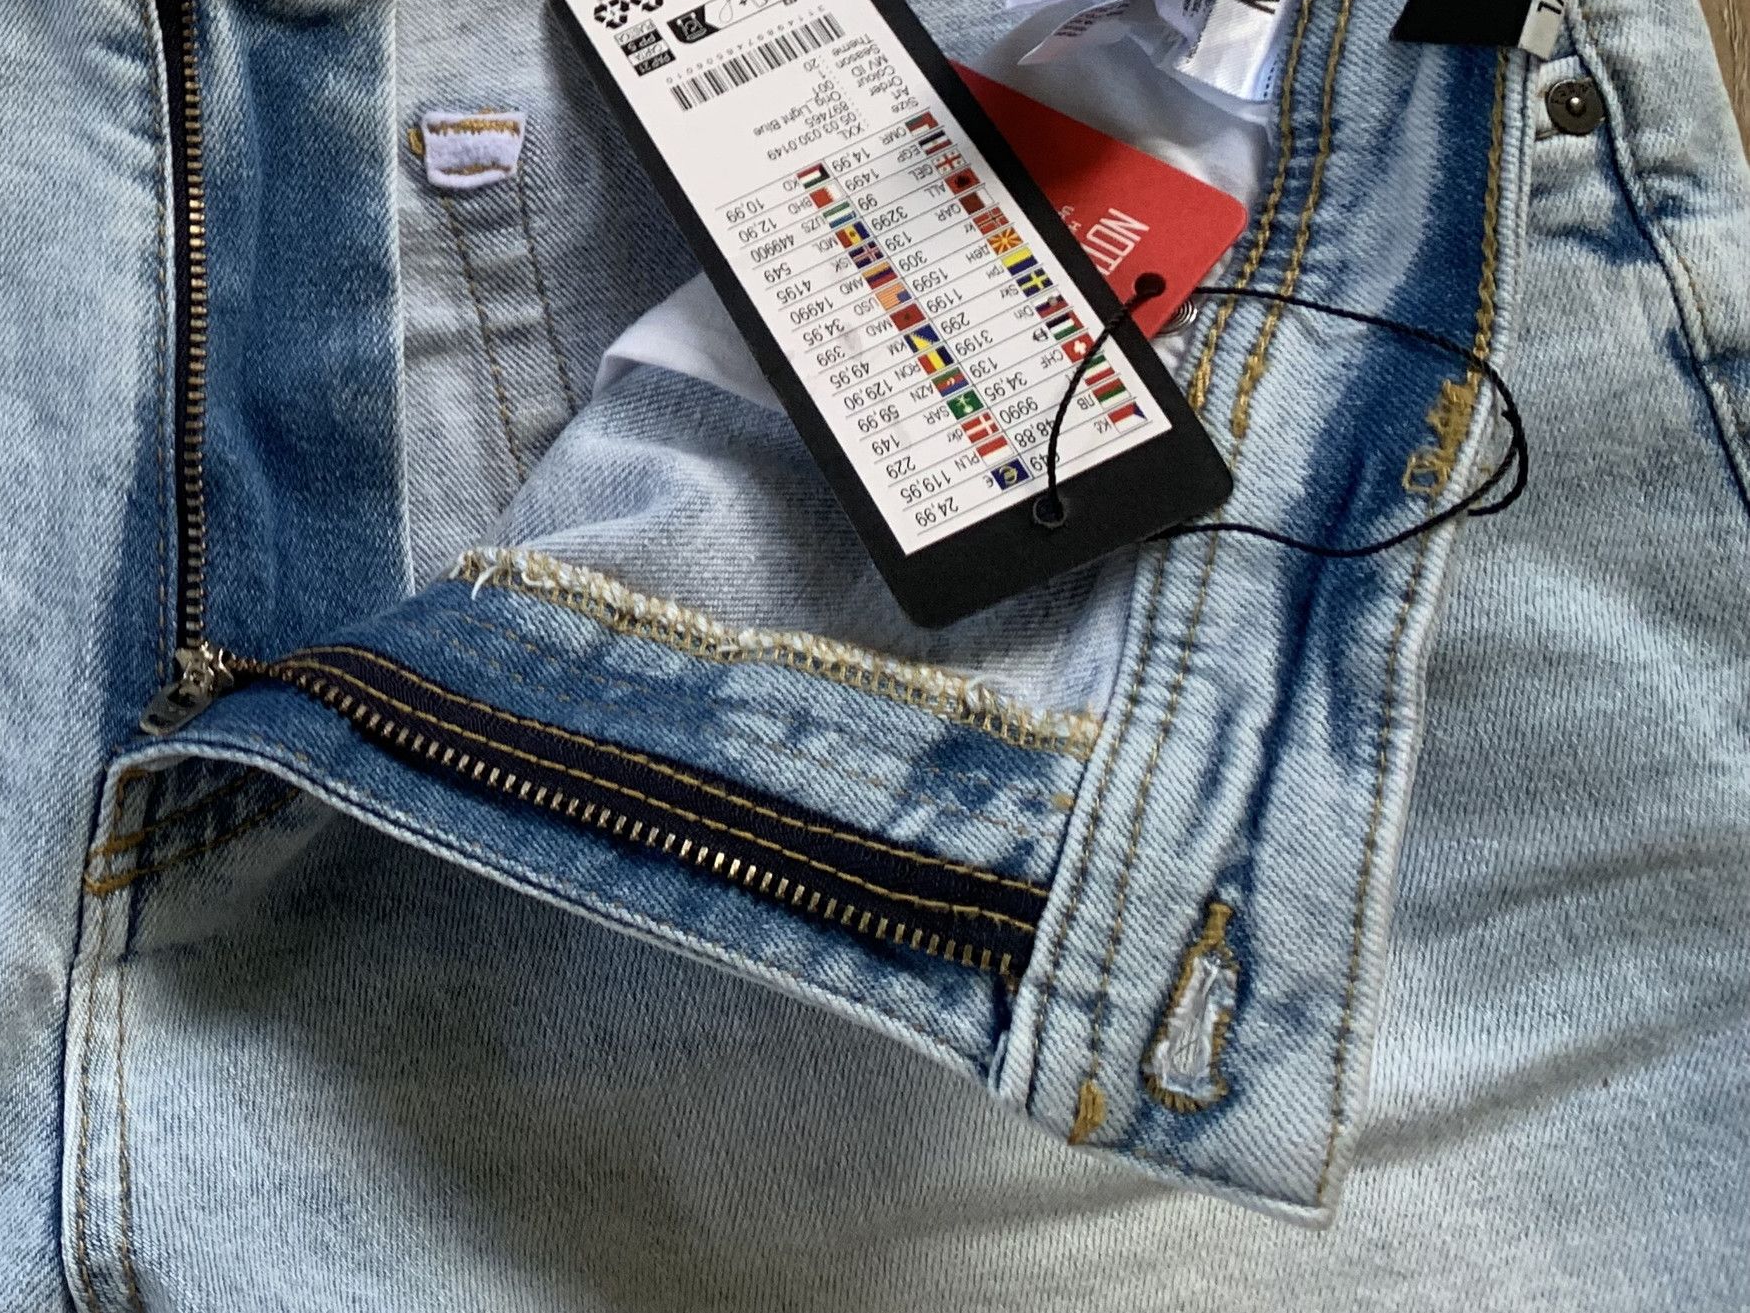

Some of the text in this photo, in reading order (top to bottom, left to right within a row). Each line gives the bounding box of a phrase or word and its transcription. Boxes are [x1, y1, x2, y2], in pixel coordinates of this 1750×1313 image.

[829, 32, 874, 58] Theme
[833, 42, 881, 71] Season
[853, 63, 897, 89] Colour
[865, 74, 904, 98] Order
[750, 117, 782, 139] Blue
[836, 95, 920, 141] Size XXL
[829, 145, 872, 174] 14,99
[842, 167, 881, 192] 1499
[854, 161, 936, 212] GEL 99
[723, 196, 766, 224] 10,99
[868, 180, 949, 232] ALL 3299
[735, 215, 778, 244] 12,90
[882, 229, 914, 252] 139
[748, 231, 798, 264] 449900
[761, 234, 839, 284] MDL 549
[895, 221, 976, 273] kr 309
[774, 254, 853, 305] ISK 4195
[909, 266, 950, 294] 1599
[787, 275, 866, 326] AMD 14990
[923, 287, 964, 315] 1199
[799, 295, 880, 347] USD 34,95
[937, 311, 971, 336] 299
[813, 317, 893, 368] MAD 399
[951, 328, 994, 357] 3199
[826, 339, 907, 390] KM 49,95
[966, 355, 1000, 380] 139
[980, 347, 1066, 402] CHF 34,95
[840, 359, 922, 411] RON 129,90
[854, 381, 937, 434] AZN 59,99
[996, 395, 1040, 425] 9990
[869, 404, 951, 457] SAR 149
[883, 454, 917, 480] 229
[1025, 445, 1063, 474] 49
[896, 450, 981, 504] PLN 119,95
[911, 473, 996, 528] € 24,99
